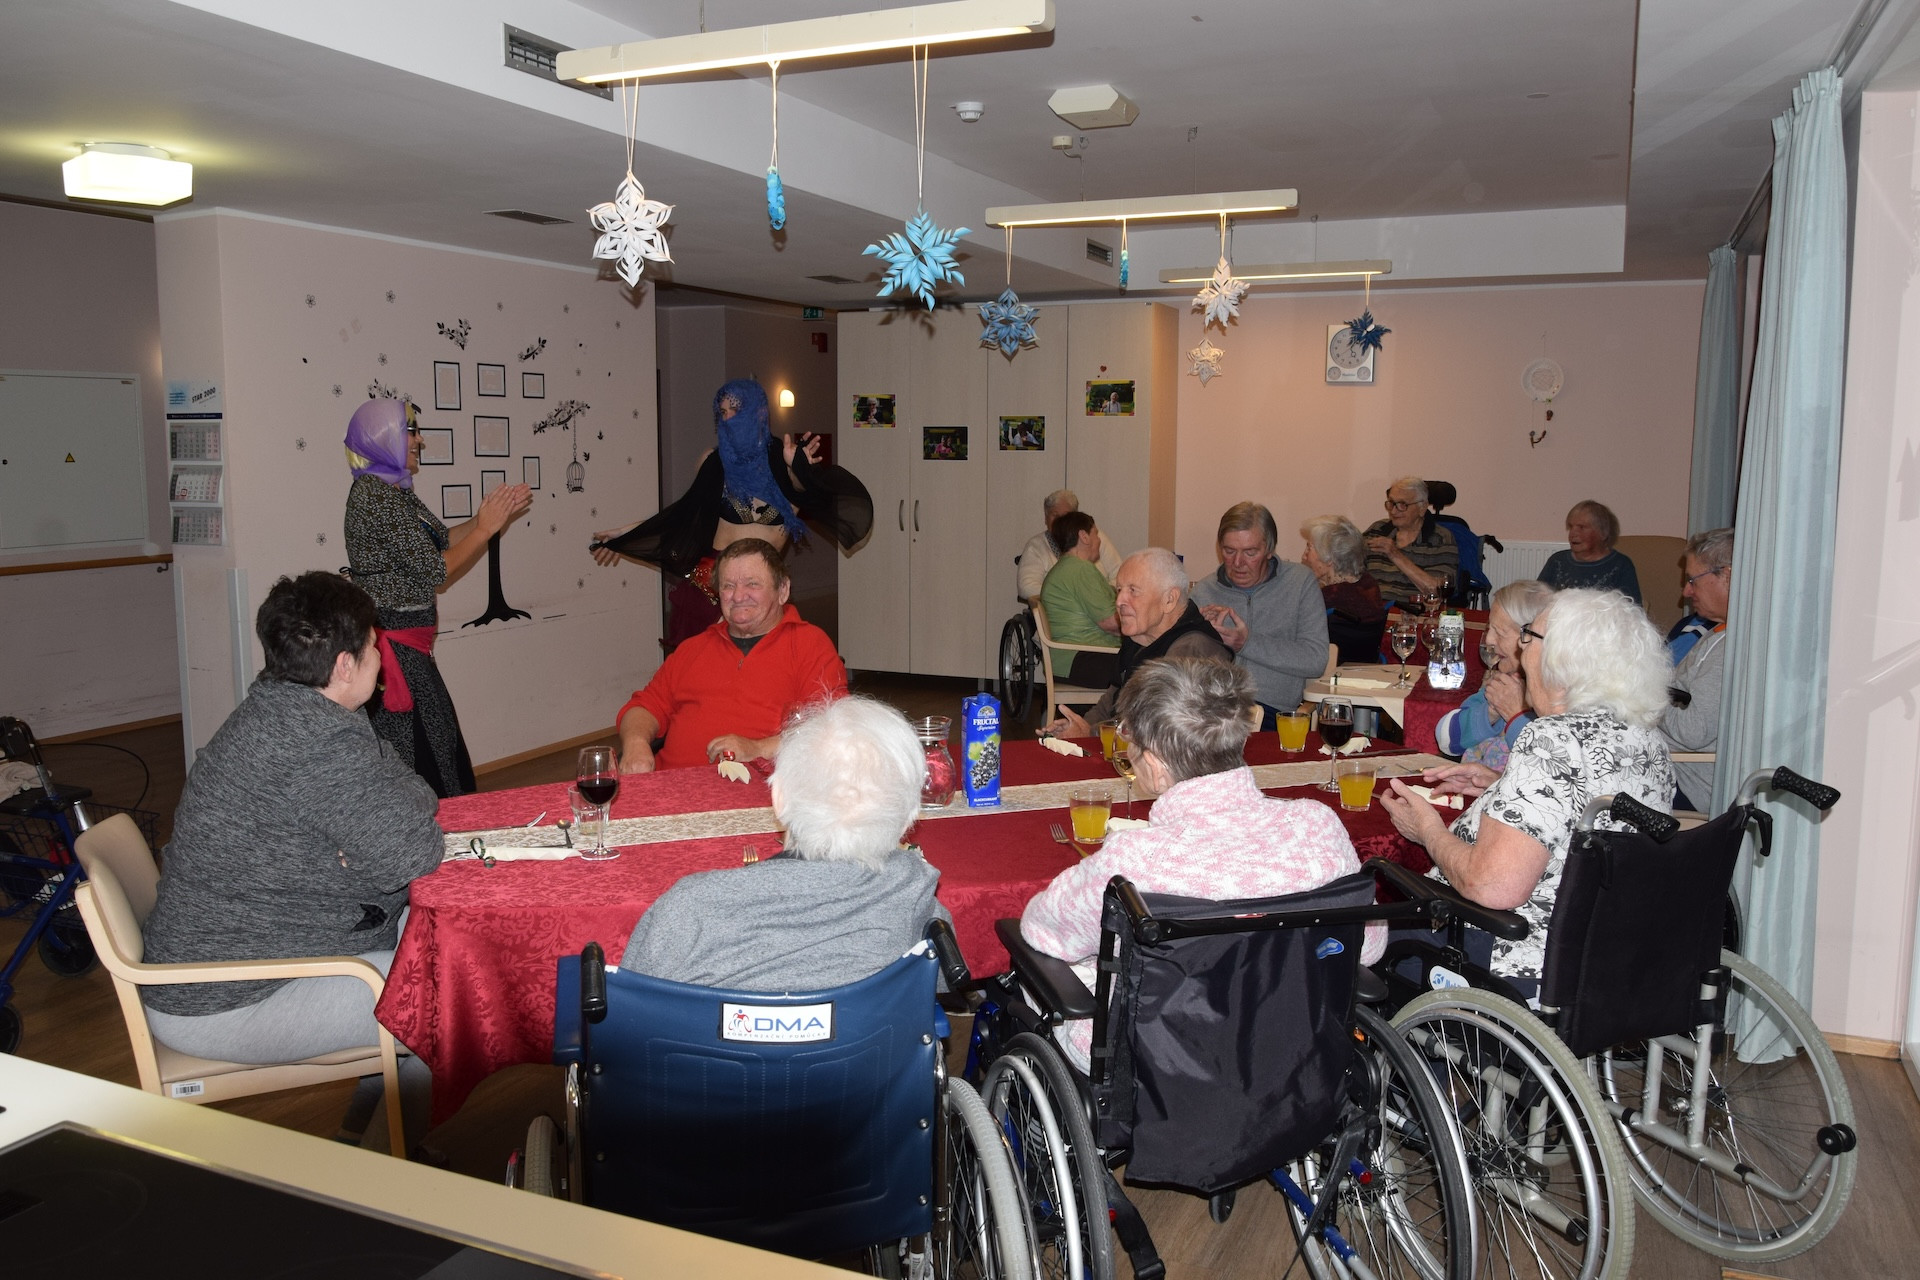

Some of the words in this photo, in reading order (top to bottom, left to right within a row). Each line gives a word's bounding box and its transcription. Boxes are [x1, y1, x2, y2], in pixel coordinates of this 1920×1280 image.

[192, 393, 203, 403] STAR
[203, 387, 216, 398] 2000
[973, 718, 999, 726] FRUCTAL
[754, 1017, 825, 1031] DMA
